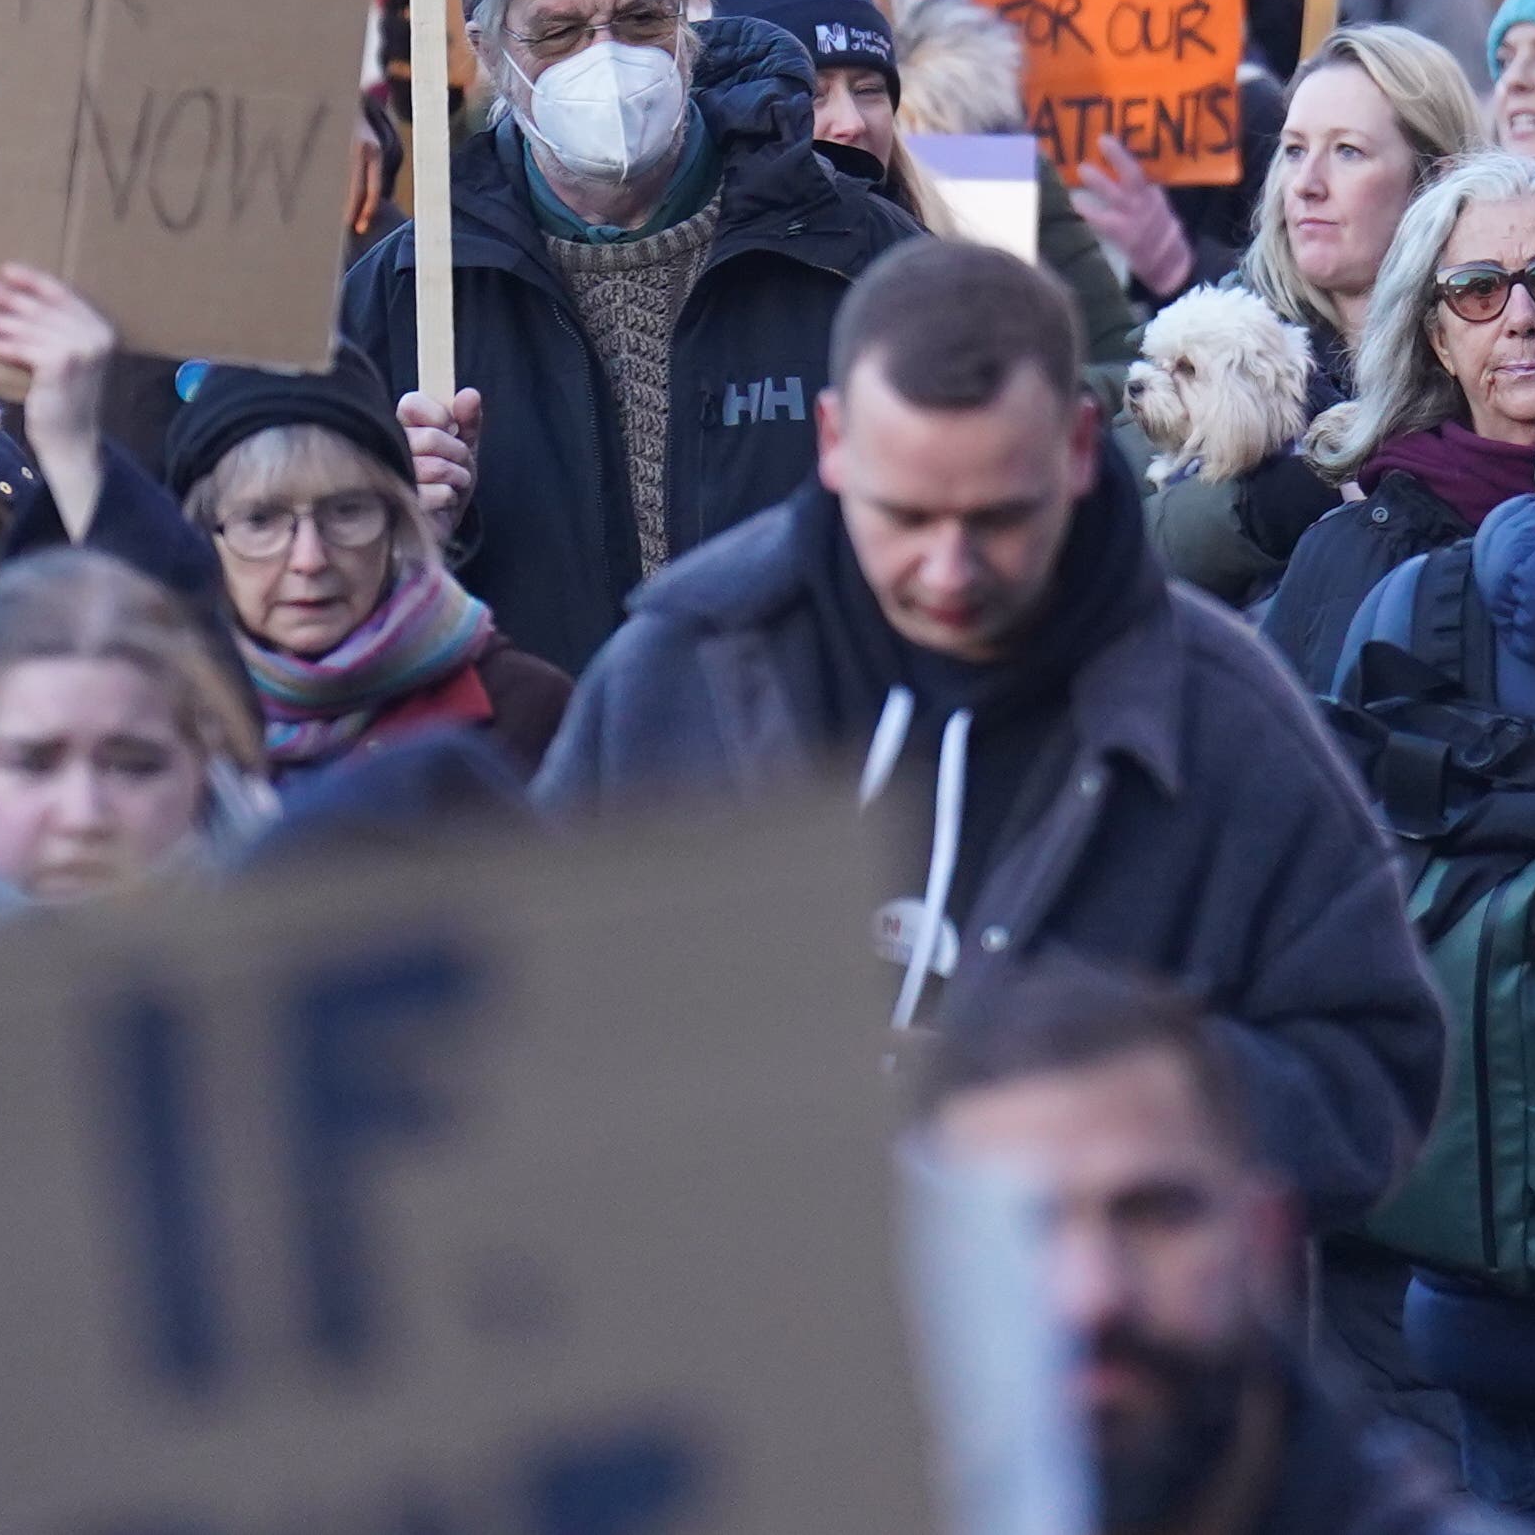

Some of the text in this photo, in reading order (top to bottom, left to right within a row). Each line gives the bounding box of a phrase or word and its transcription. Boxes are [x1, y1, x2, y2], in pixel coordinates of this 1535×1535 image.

[1104, 0, 1217, 62] OUR
[66, 87, 329, 233] NOW
[1031, 82, 1233, 165] ATIENTS
